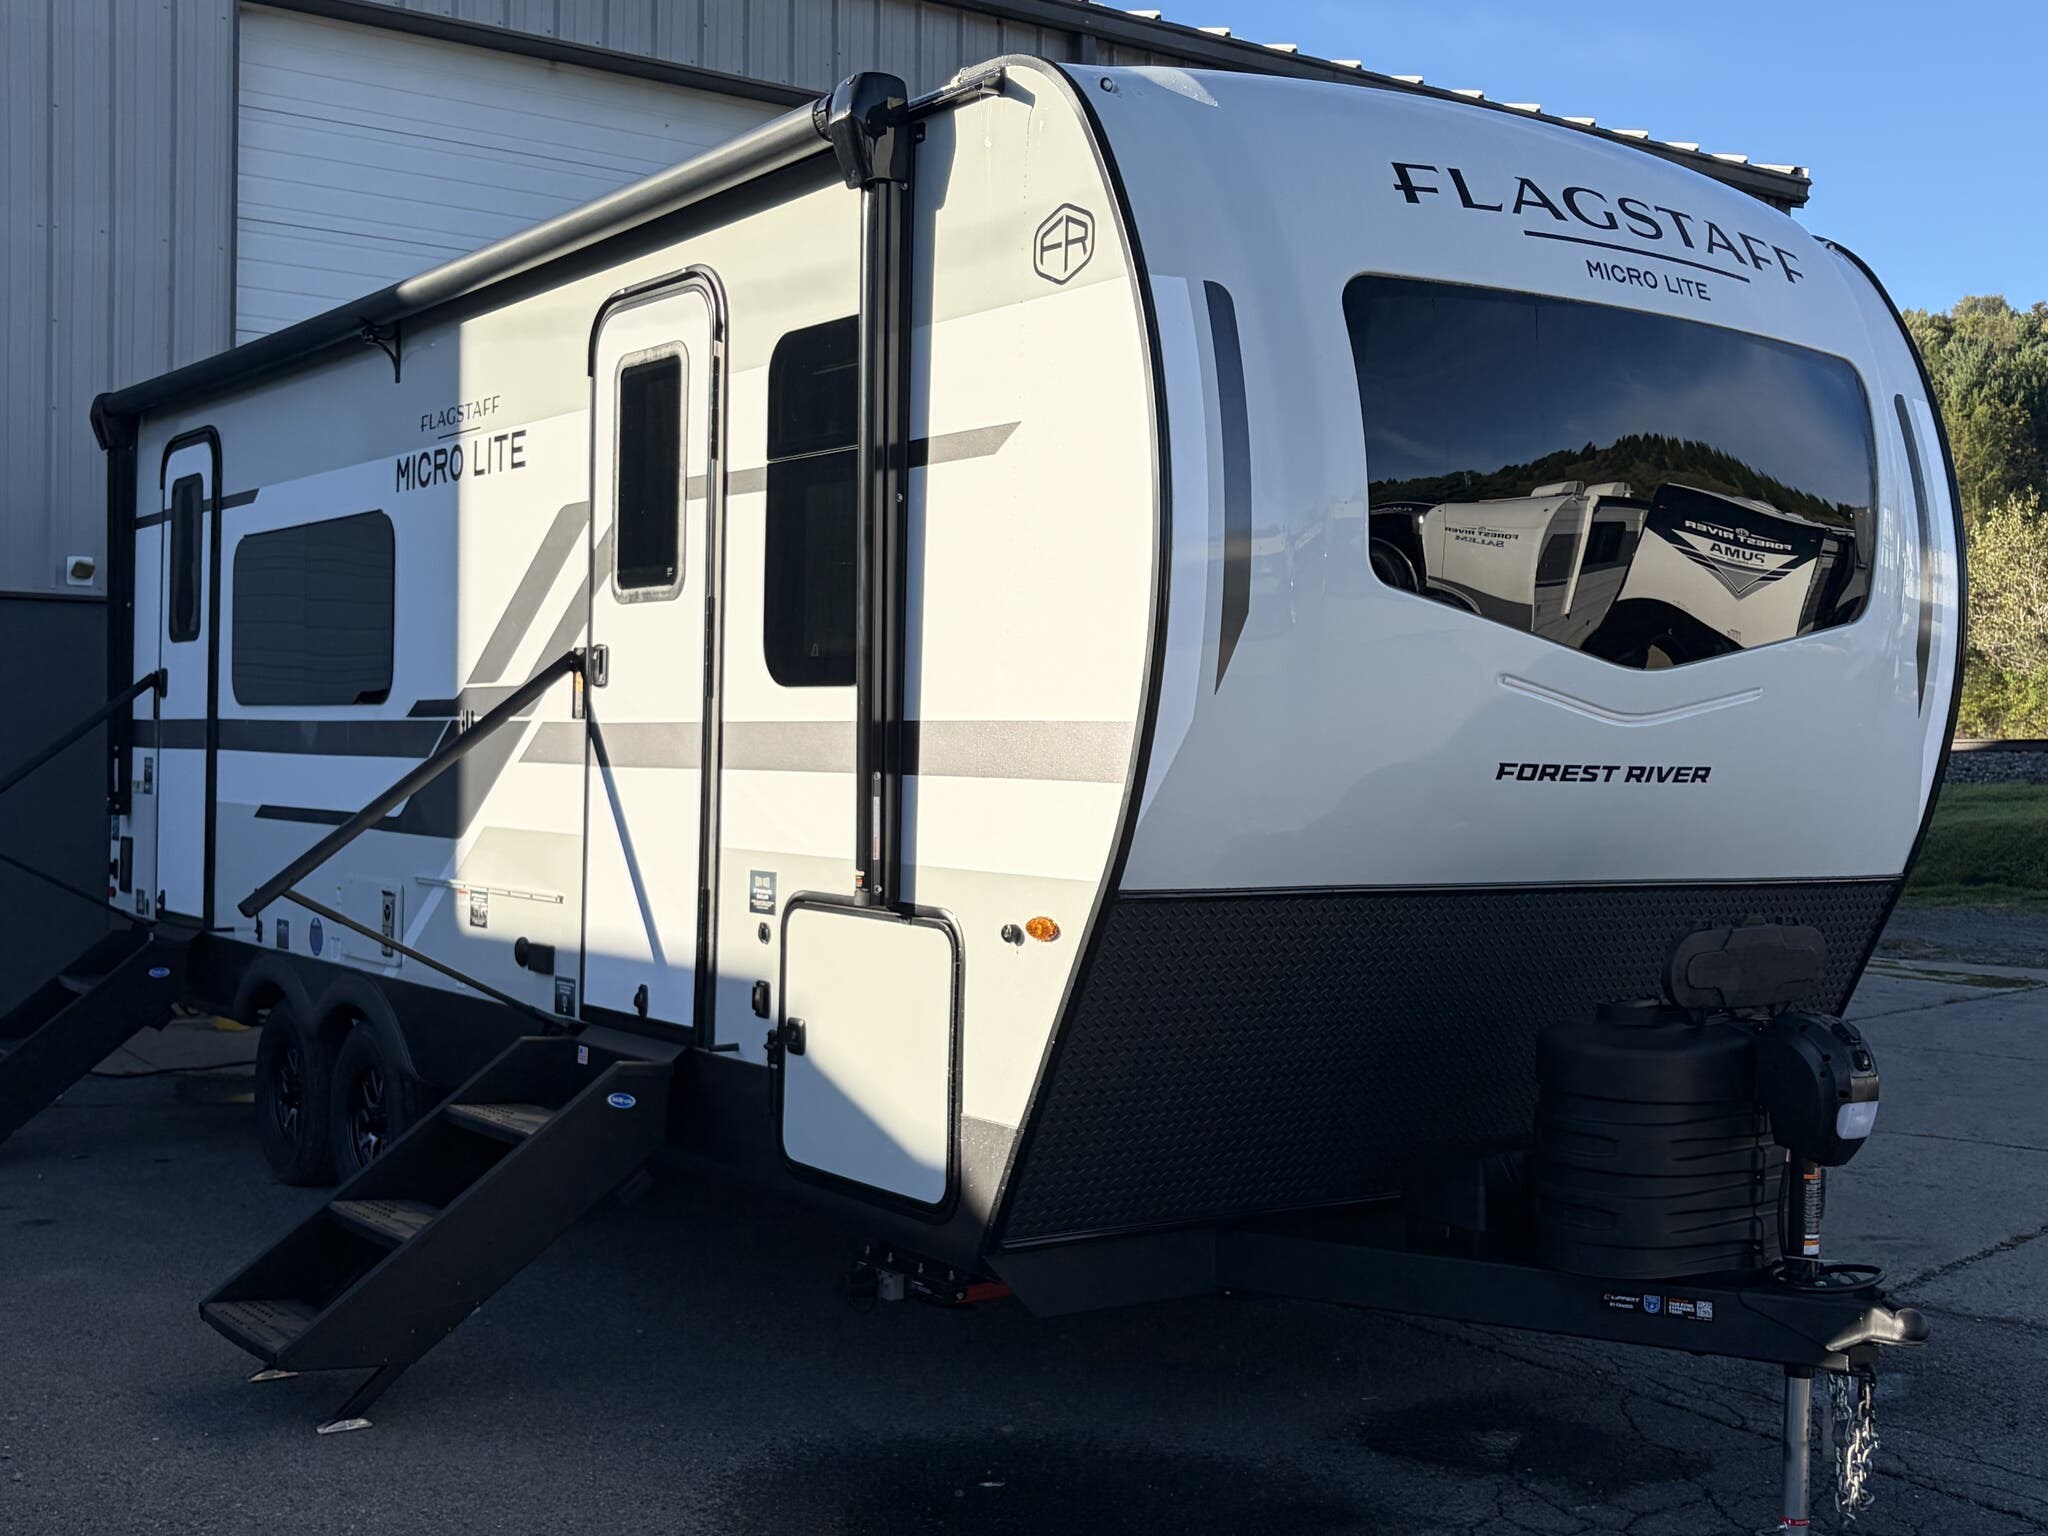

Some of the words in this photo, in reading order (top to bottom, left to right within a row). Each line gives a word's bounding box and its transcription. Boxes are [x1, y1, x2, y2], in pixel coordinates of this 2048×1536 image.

[1390, 161, 1805, 284] FLAGSTAFF
[1586, 259, 1658, 290] MICRO
[1665, 274, 1712, 302] LITE
[420, 394, 501, 433] FLAGSTAFF
[396, 443, 465, 493] MICRO
[473, 429, 527, 477] LITE
[1495, 762, 1621, 783] FOREST
[1624, 765, 1712, 784] RIVER
